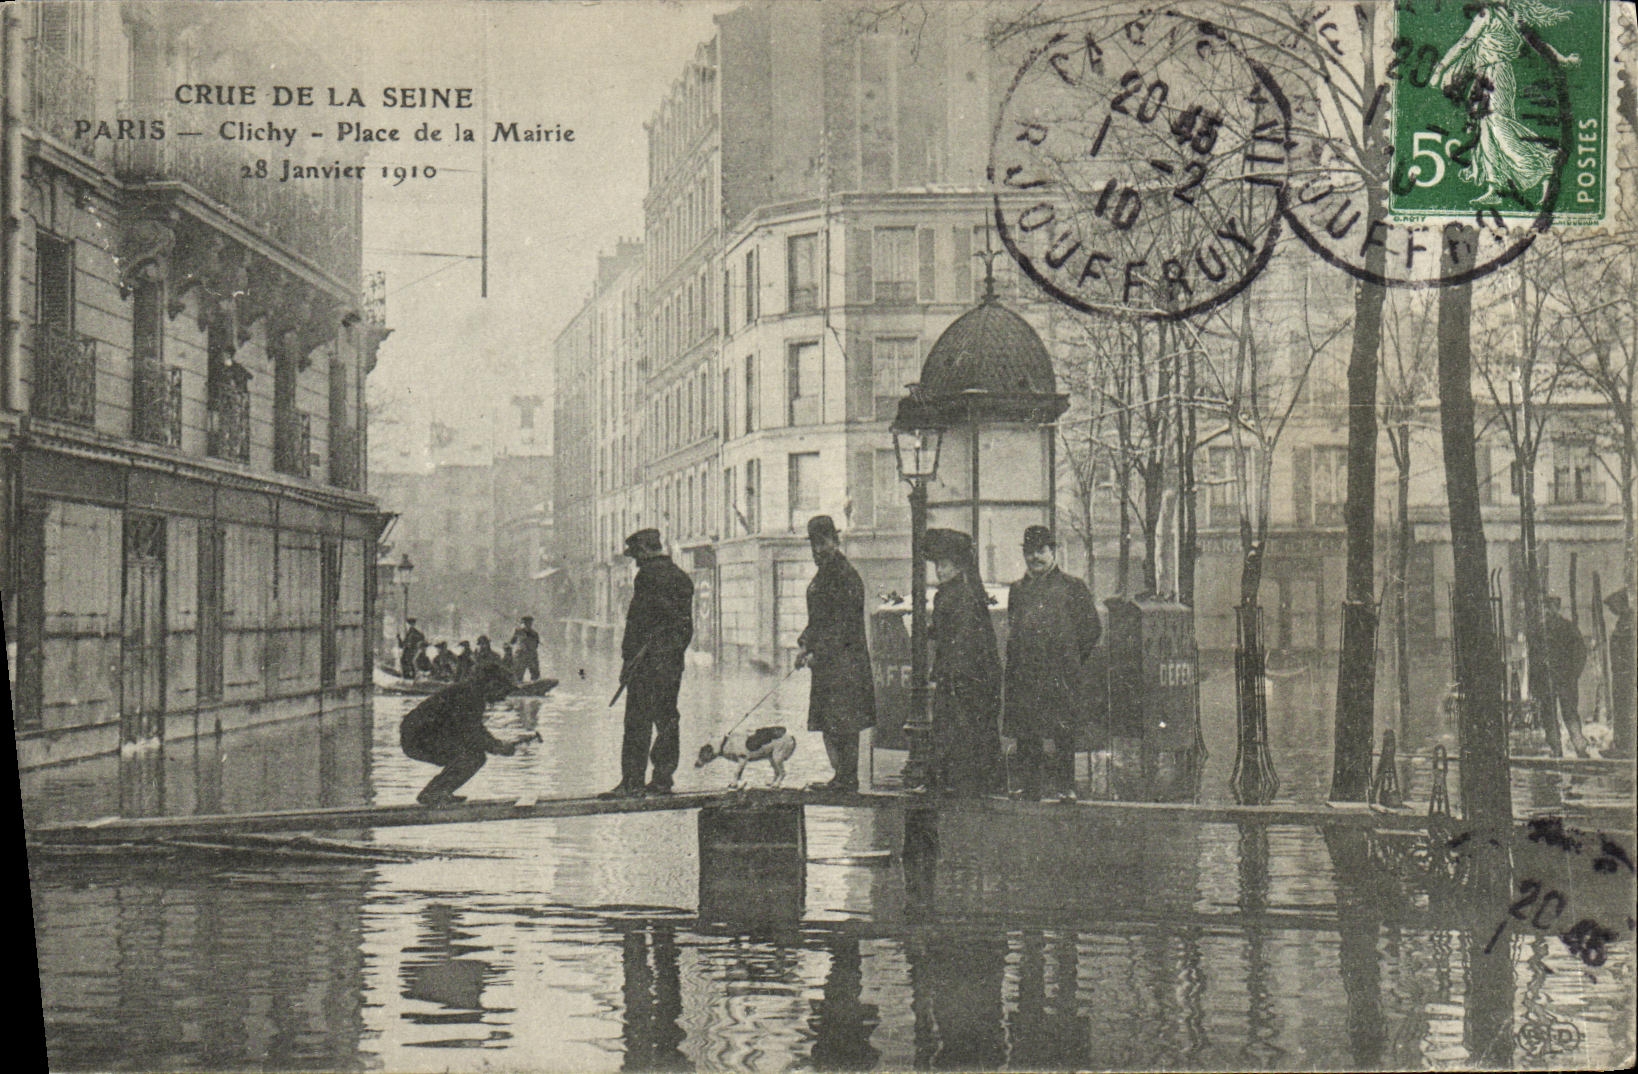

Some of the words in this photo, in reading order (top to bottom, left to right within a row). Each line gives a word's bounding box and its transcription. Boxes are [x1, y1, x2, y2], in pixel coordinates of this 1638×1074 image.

[1111, 70, 1168, 123] 20
[1577, 118, 1598, 203] POSTES
[1095, 178, 1143, 230] 10
[1508, 878, 1568, 931] 20
